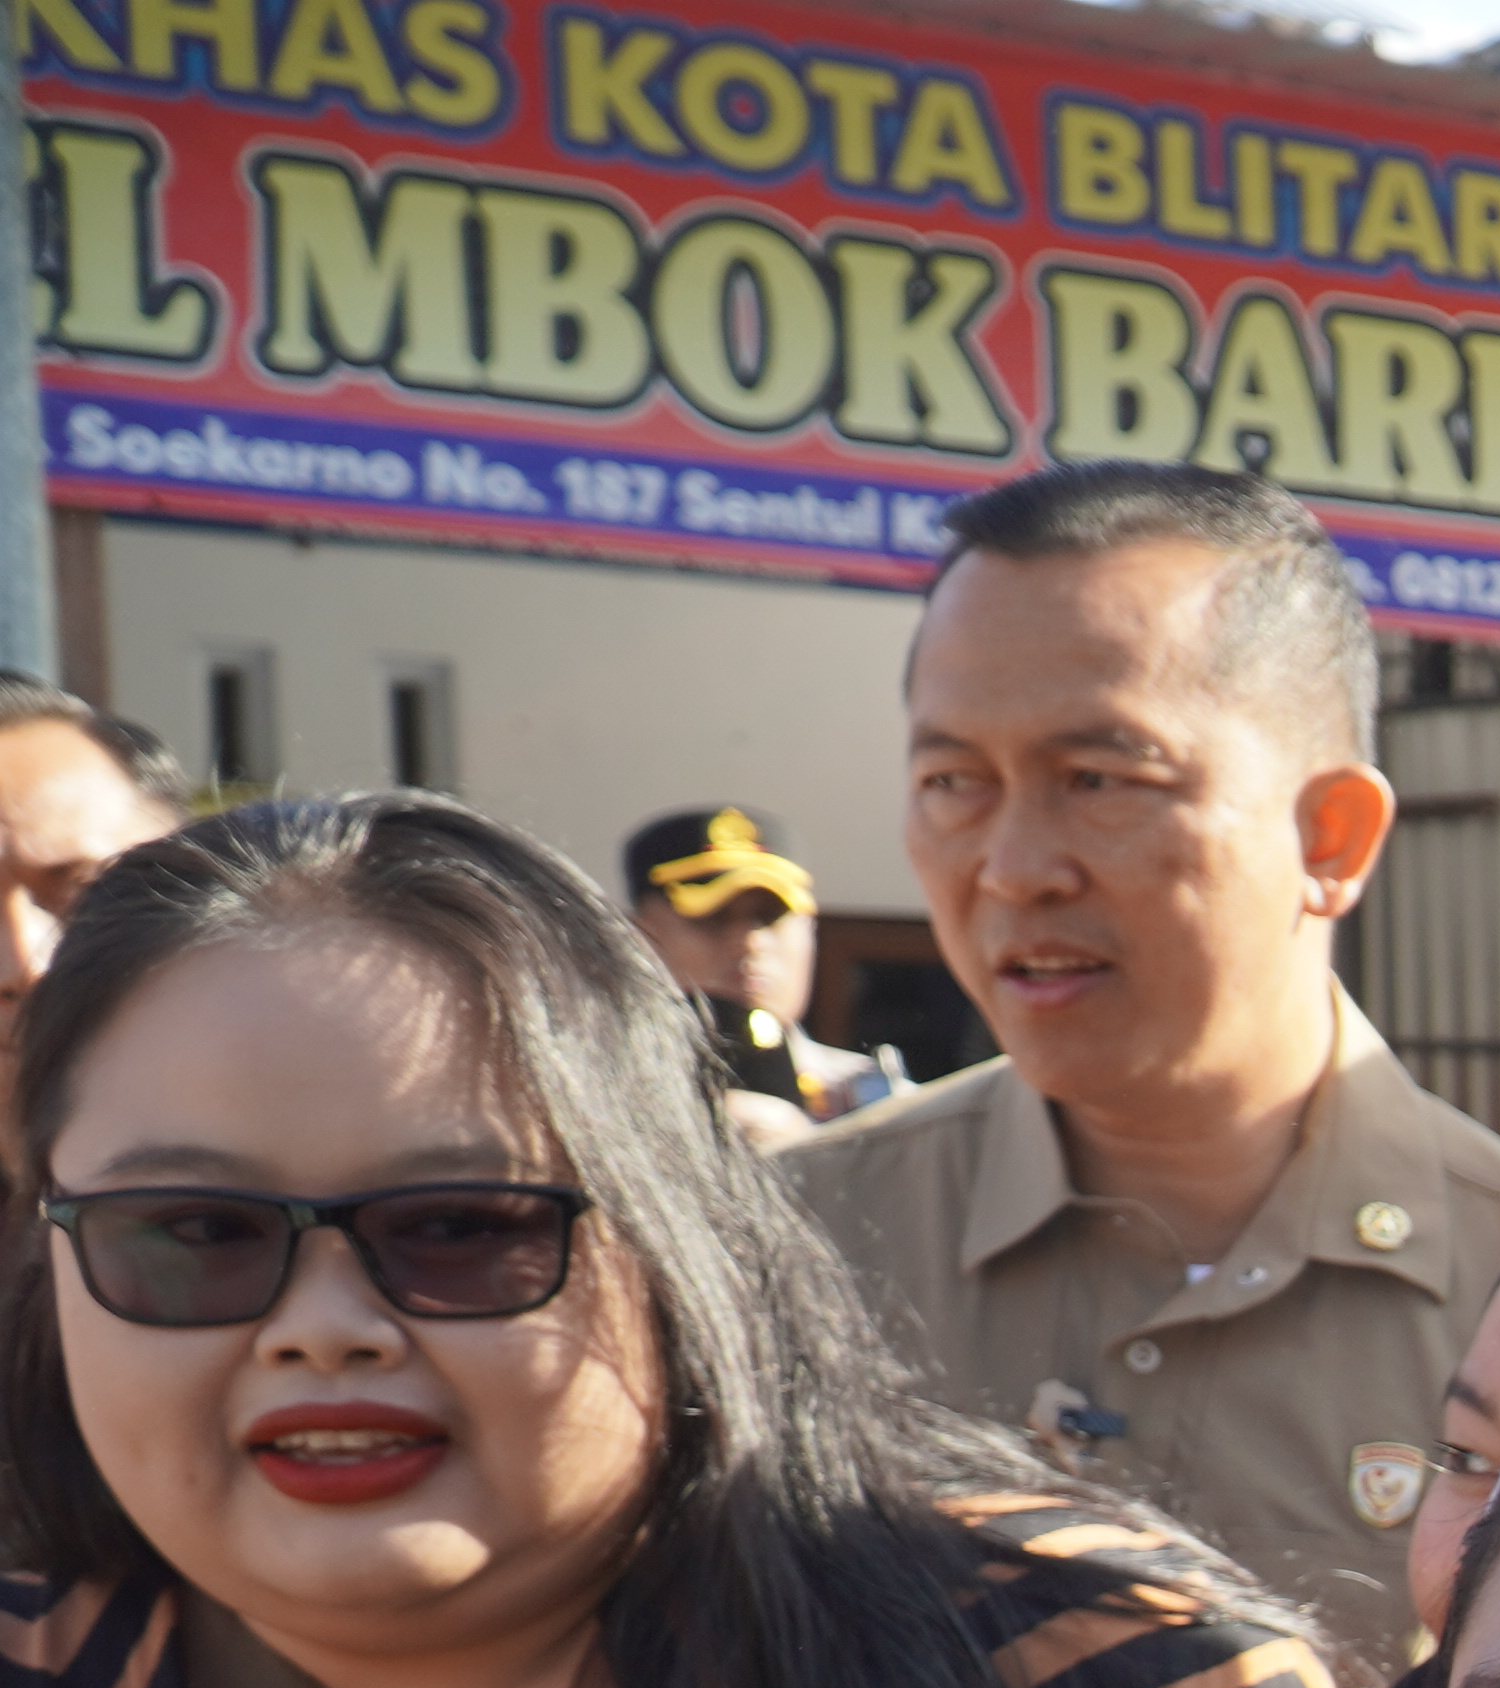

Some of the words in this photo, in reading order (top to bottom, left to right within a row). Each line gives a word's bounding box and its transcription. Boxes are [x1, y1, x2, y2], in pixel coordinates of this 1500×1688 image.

[556, 23, 1012, 208] KOTA
[22, 126, 207, 358] L
[257, 152, 1010, 458] MBOK
[65, 402, 415, 501] Soekarno
[421, 439, 549, 515] No.
[553, 456, 668, 528] 187
[674, 467, 882, 550] Sentul
